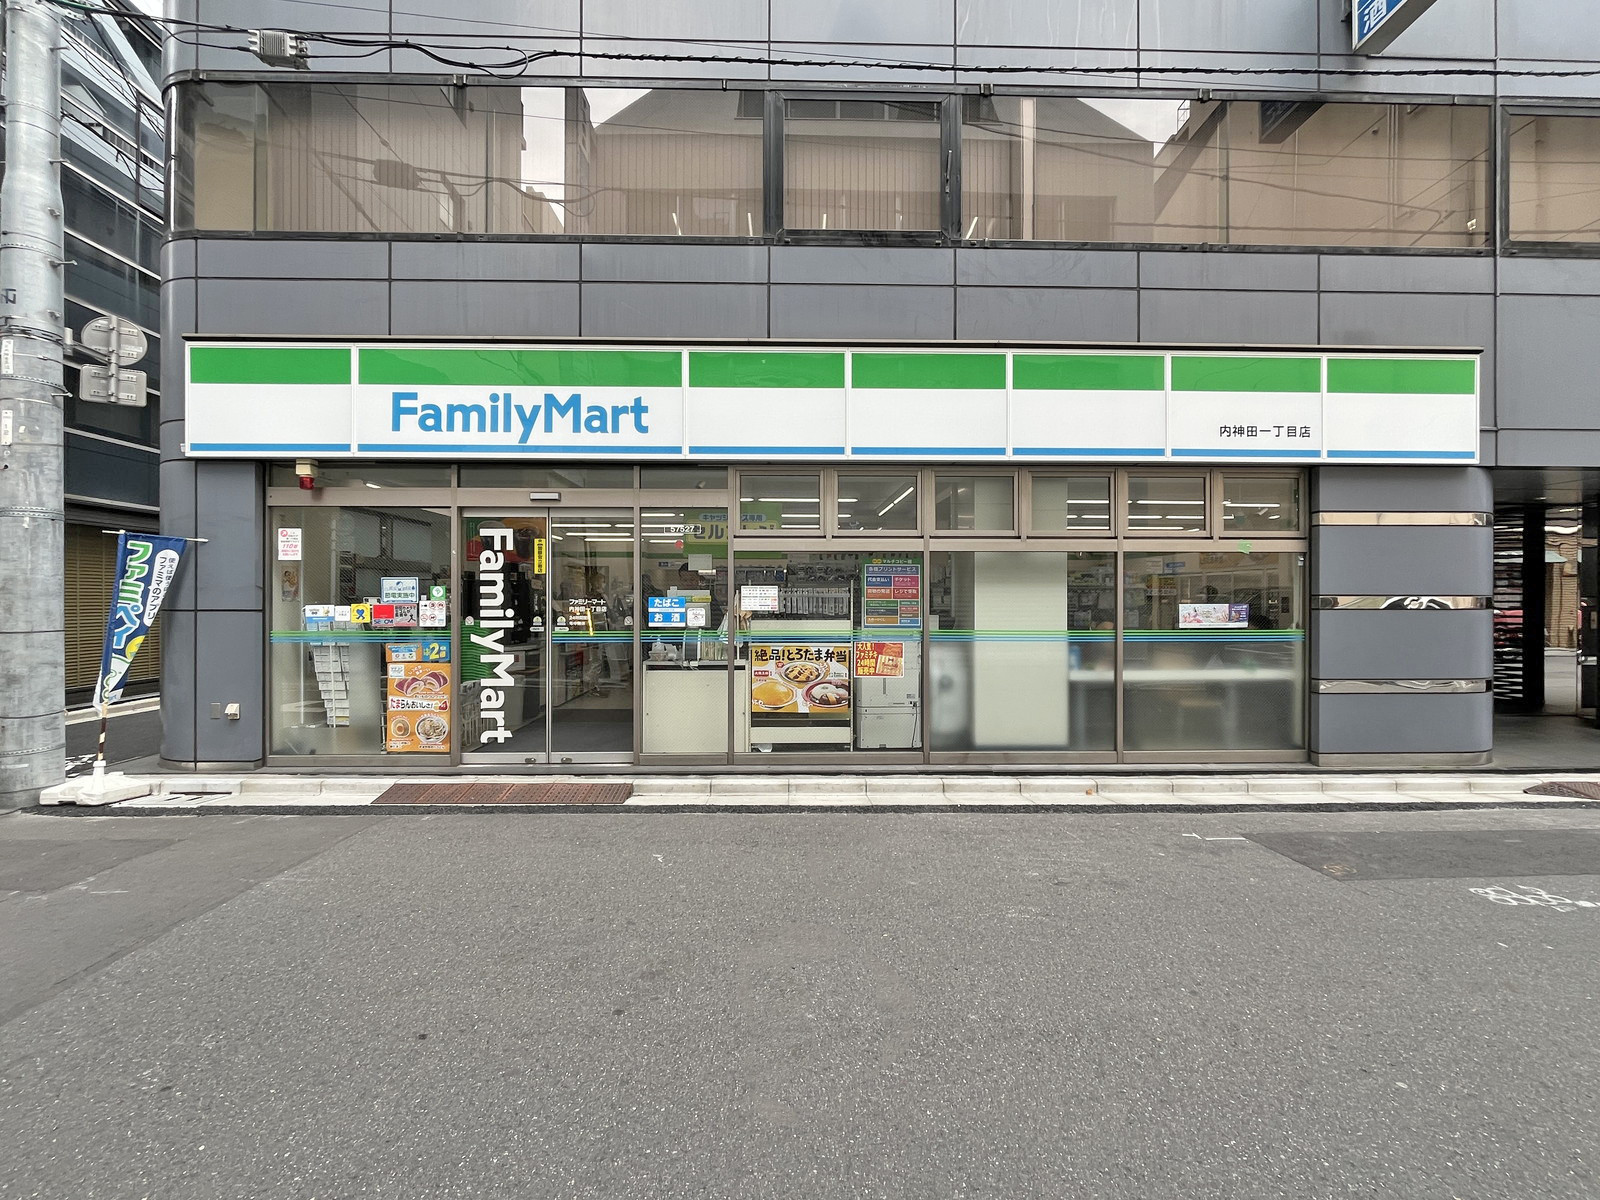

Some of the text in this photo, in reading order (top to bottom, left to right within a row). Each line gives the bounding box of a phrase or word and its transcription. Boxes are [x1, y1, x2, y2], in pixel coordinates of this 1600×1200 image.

[392, 391, 649, 444] FamilyMart
[1219, 424, 1311, 438] 内神田一丁目店
[669, 525, 695, 533] 57527
[113, 540, 153, 649] ファミペイ
[653, 598, 680, 608] たばこ
[470, 528, 515, 744] FamilyMart
[754, 648, 847, 662] 絶品!とろたま弁当
